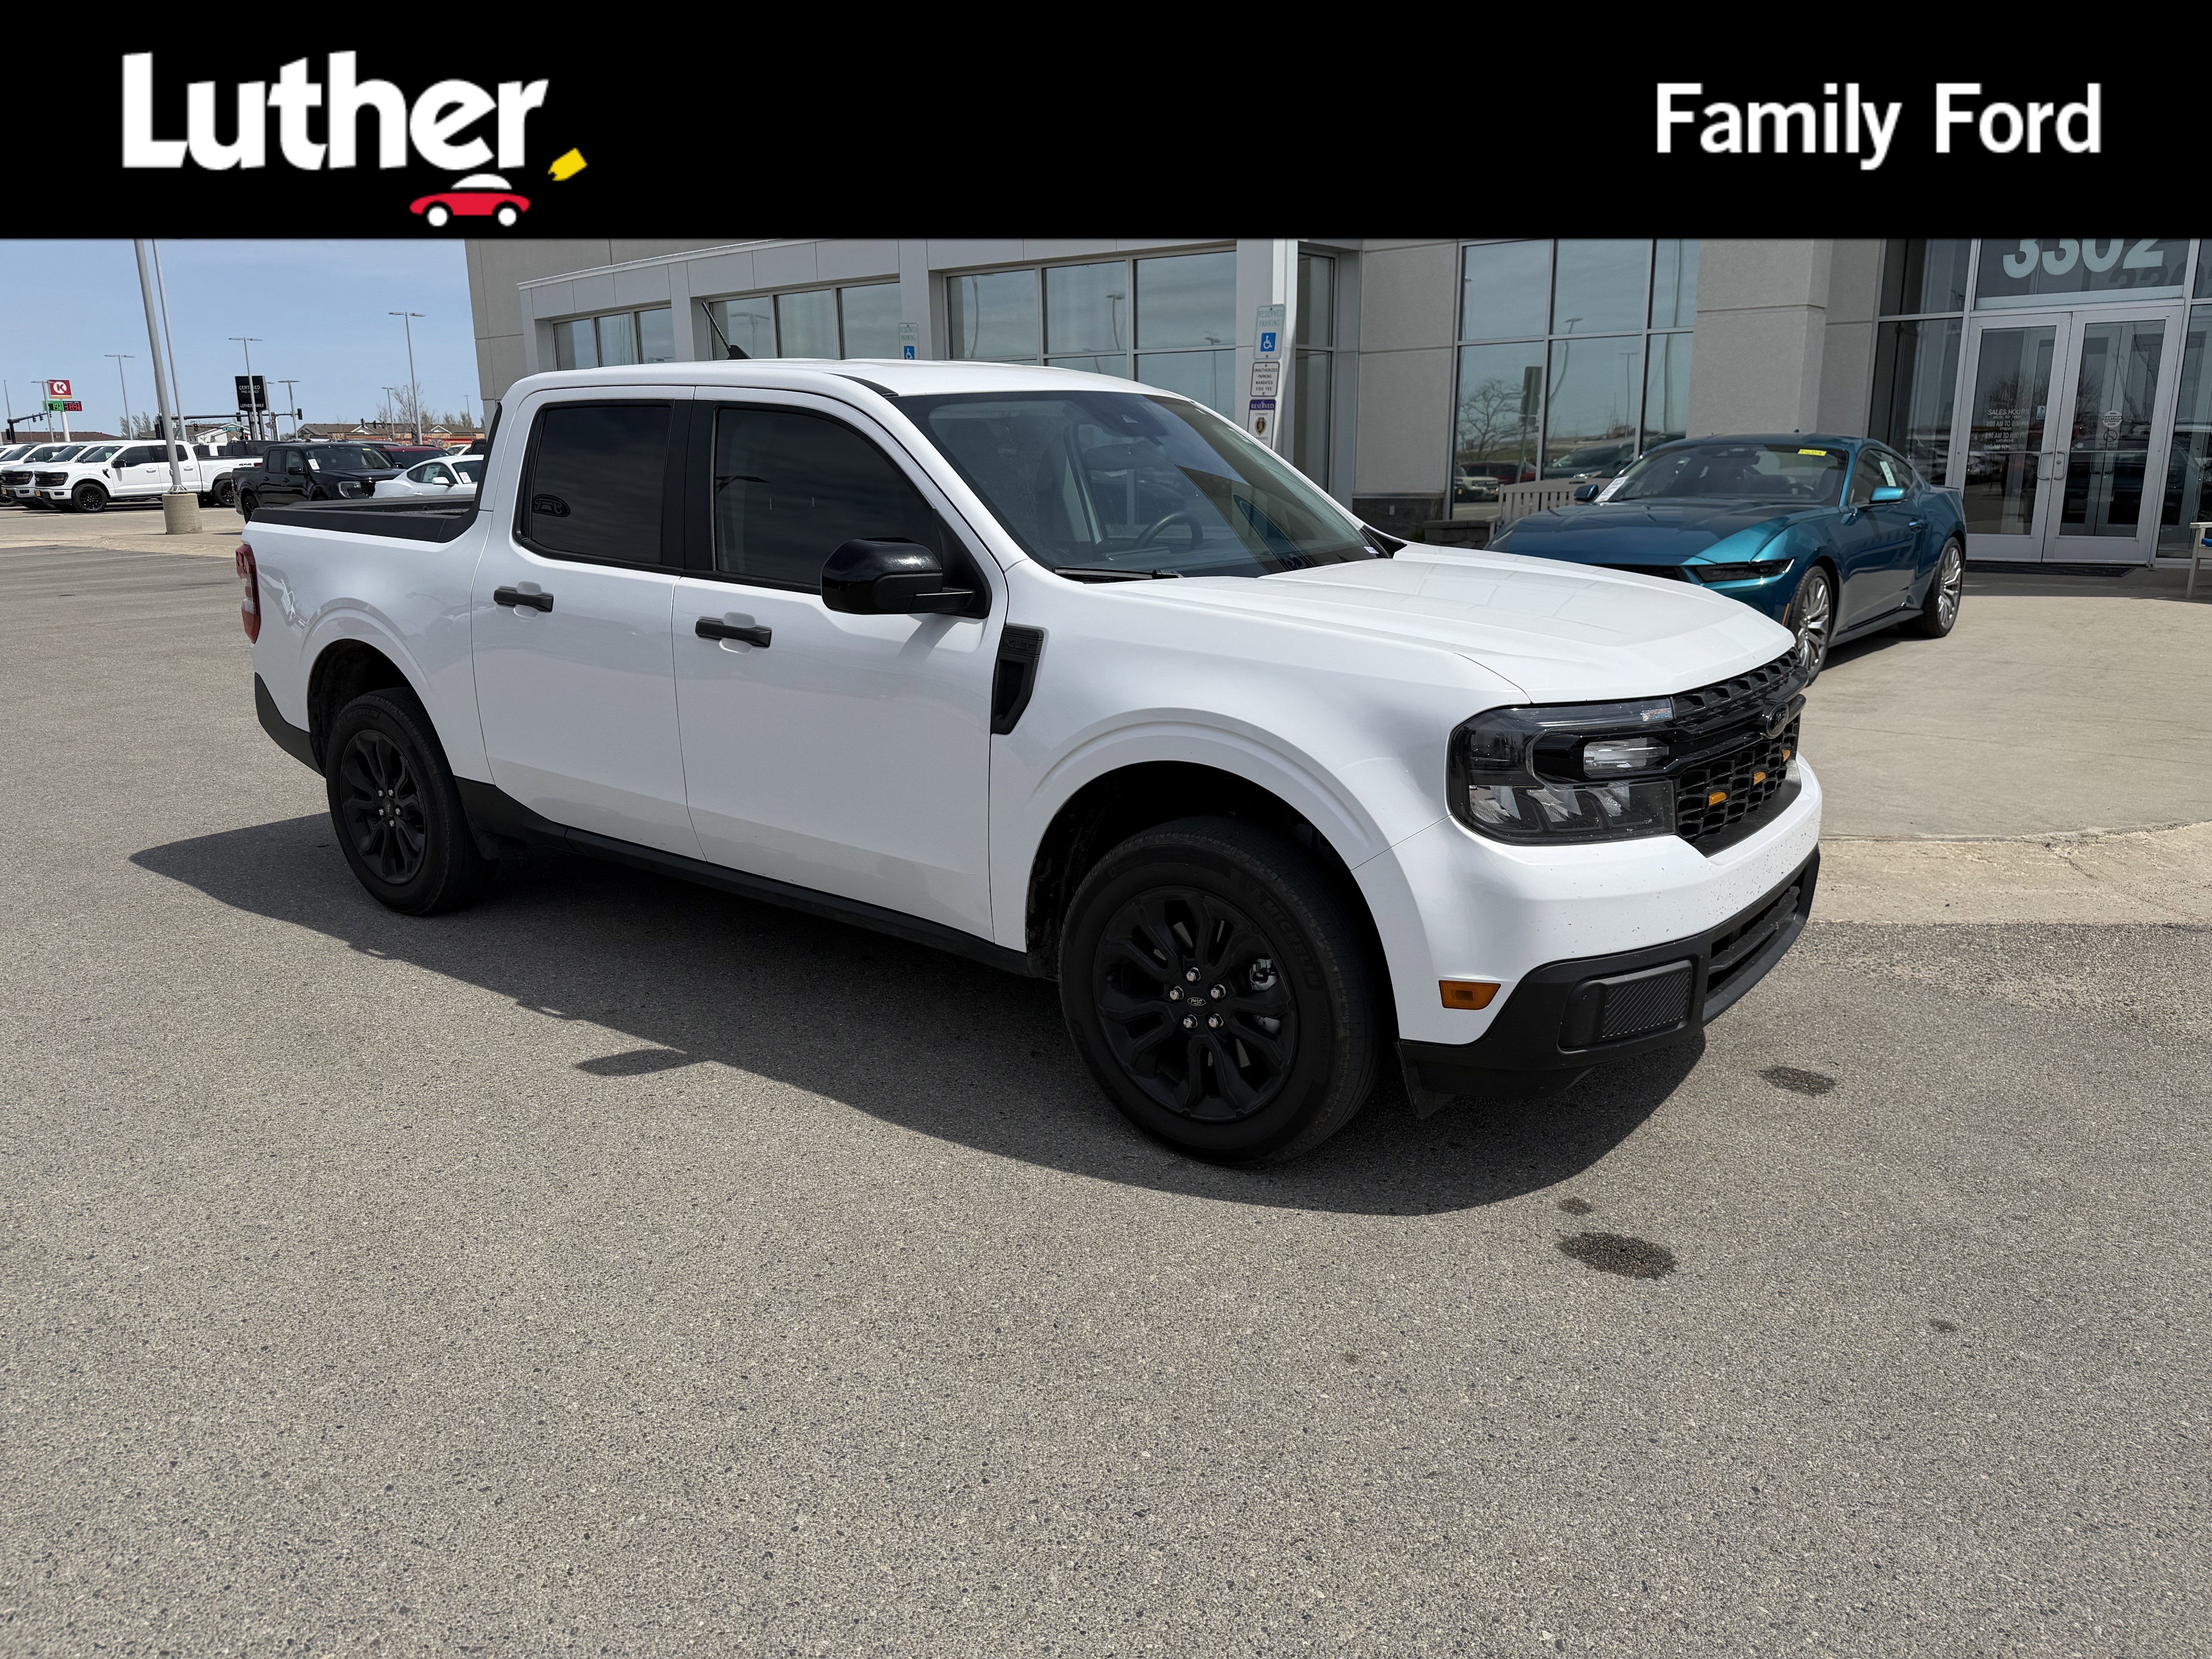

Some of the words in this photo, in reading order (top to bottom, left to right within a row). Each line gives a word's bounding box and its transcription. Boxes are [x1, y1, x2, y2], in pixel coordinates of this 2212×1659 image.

[2003, 238, 2164, 278] 3302
[1001, 639, 1036, 651] XLT
[1261, 900, 1319, 986] MICHELIN
